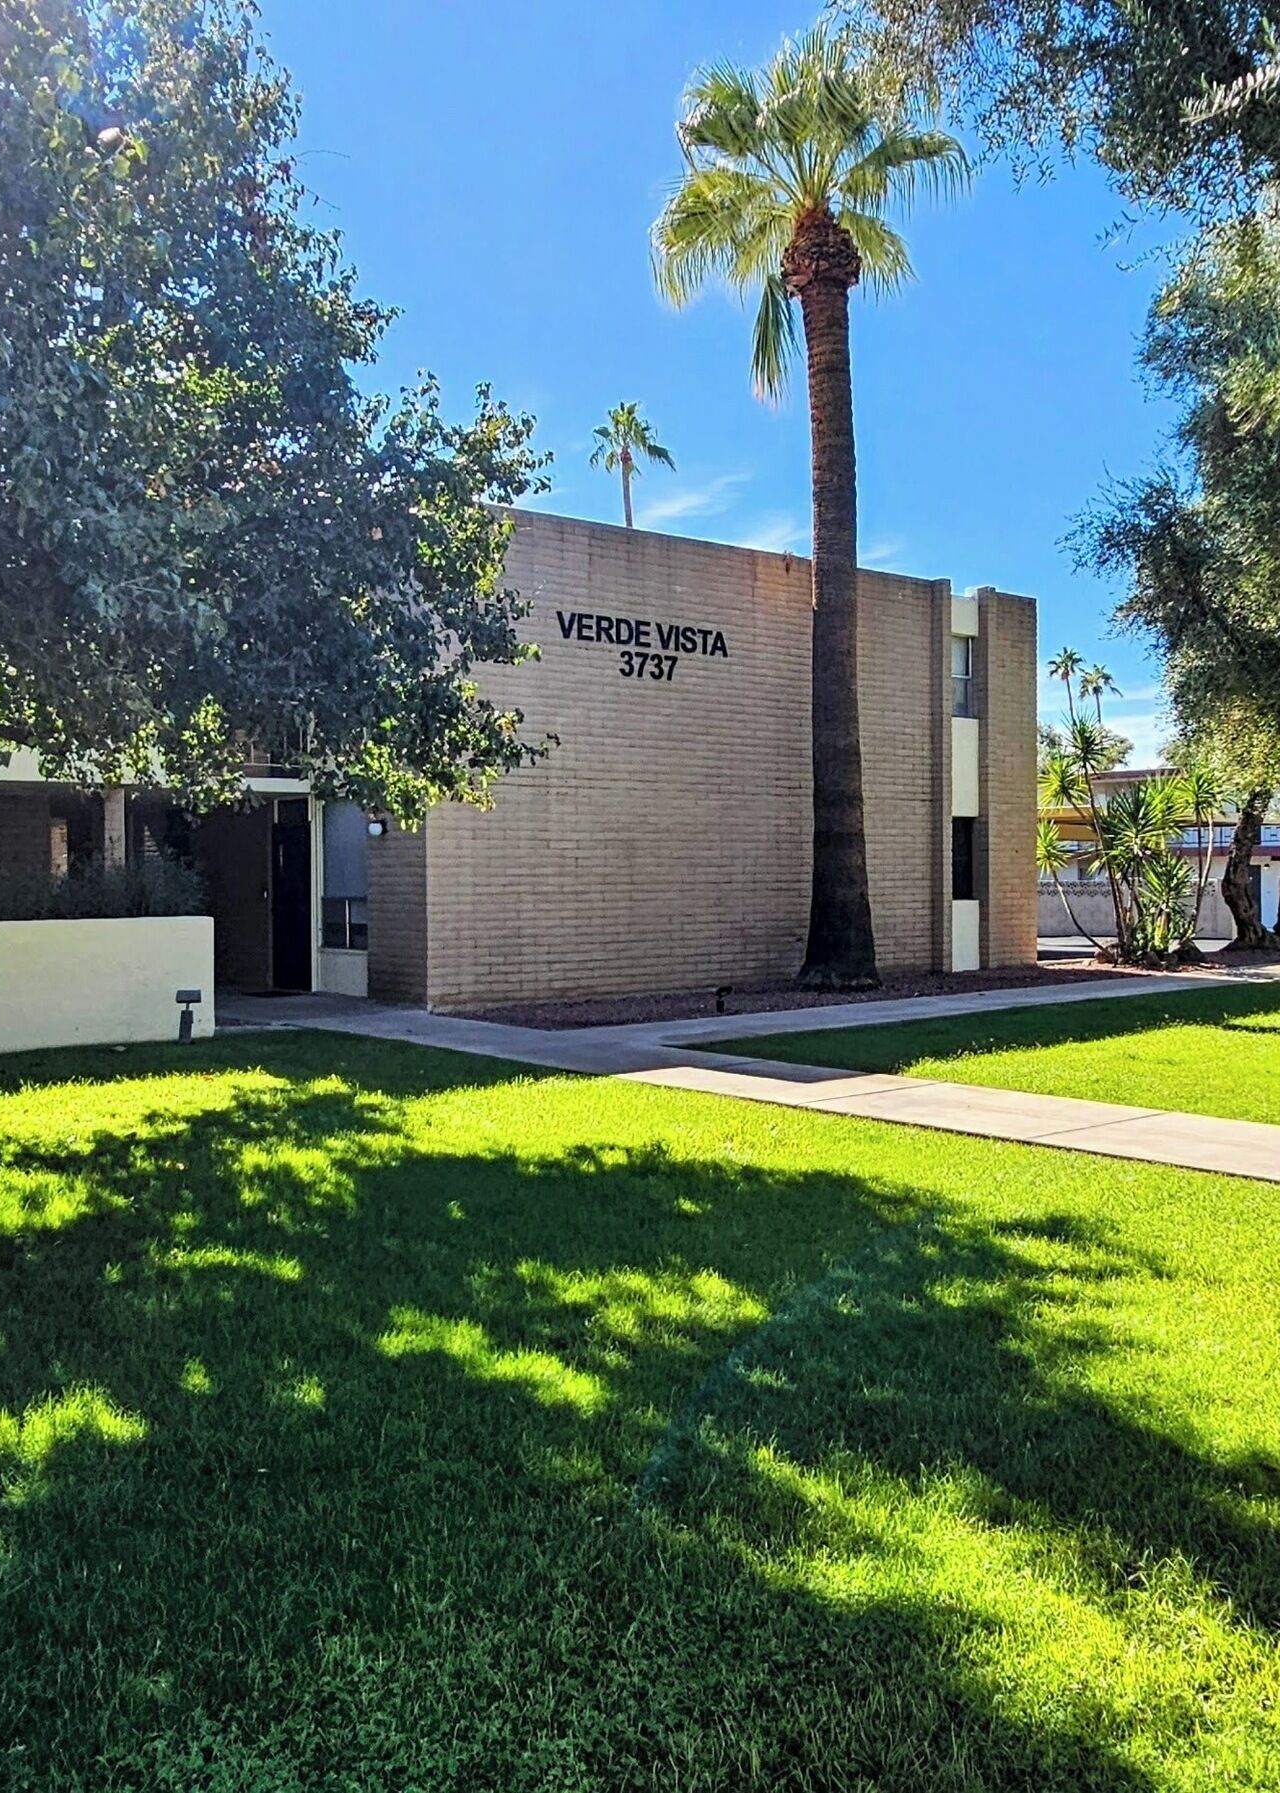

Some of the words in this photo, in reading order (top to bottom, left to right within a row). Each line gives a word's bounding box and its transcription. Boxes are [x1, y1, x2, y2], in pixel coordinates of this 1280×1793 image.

[556, 611, 651, 648] VERDE
[655, 622, 729, 658] VISTA
[619, 650, 678, 681] 3737
